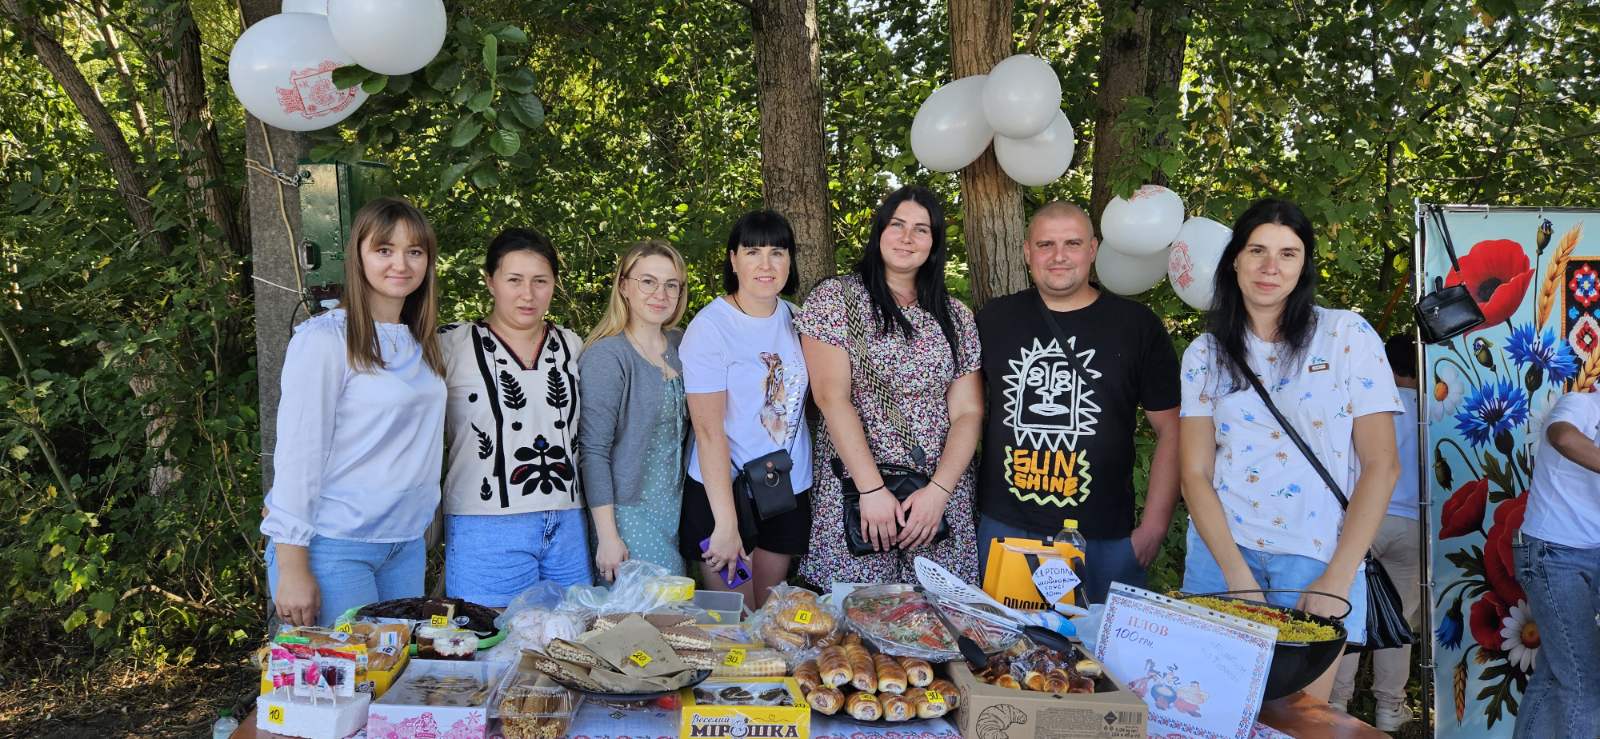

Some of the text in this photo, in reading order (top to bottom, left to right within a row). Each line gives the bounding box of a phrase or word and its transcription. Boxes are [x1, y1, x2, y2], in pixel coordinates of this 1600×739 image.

[1013, 449, 1076, 477] SUN
[1013, 472, 1079, 497] SHINE
[1128, 615, 1169, 637] ПЛОВ
[269, 709, 280, 720] 10
